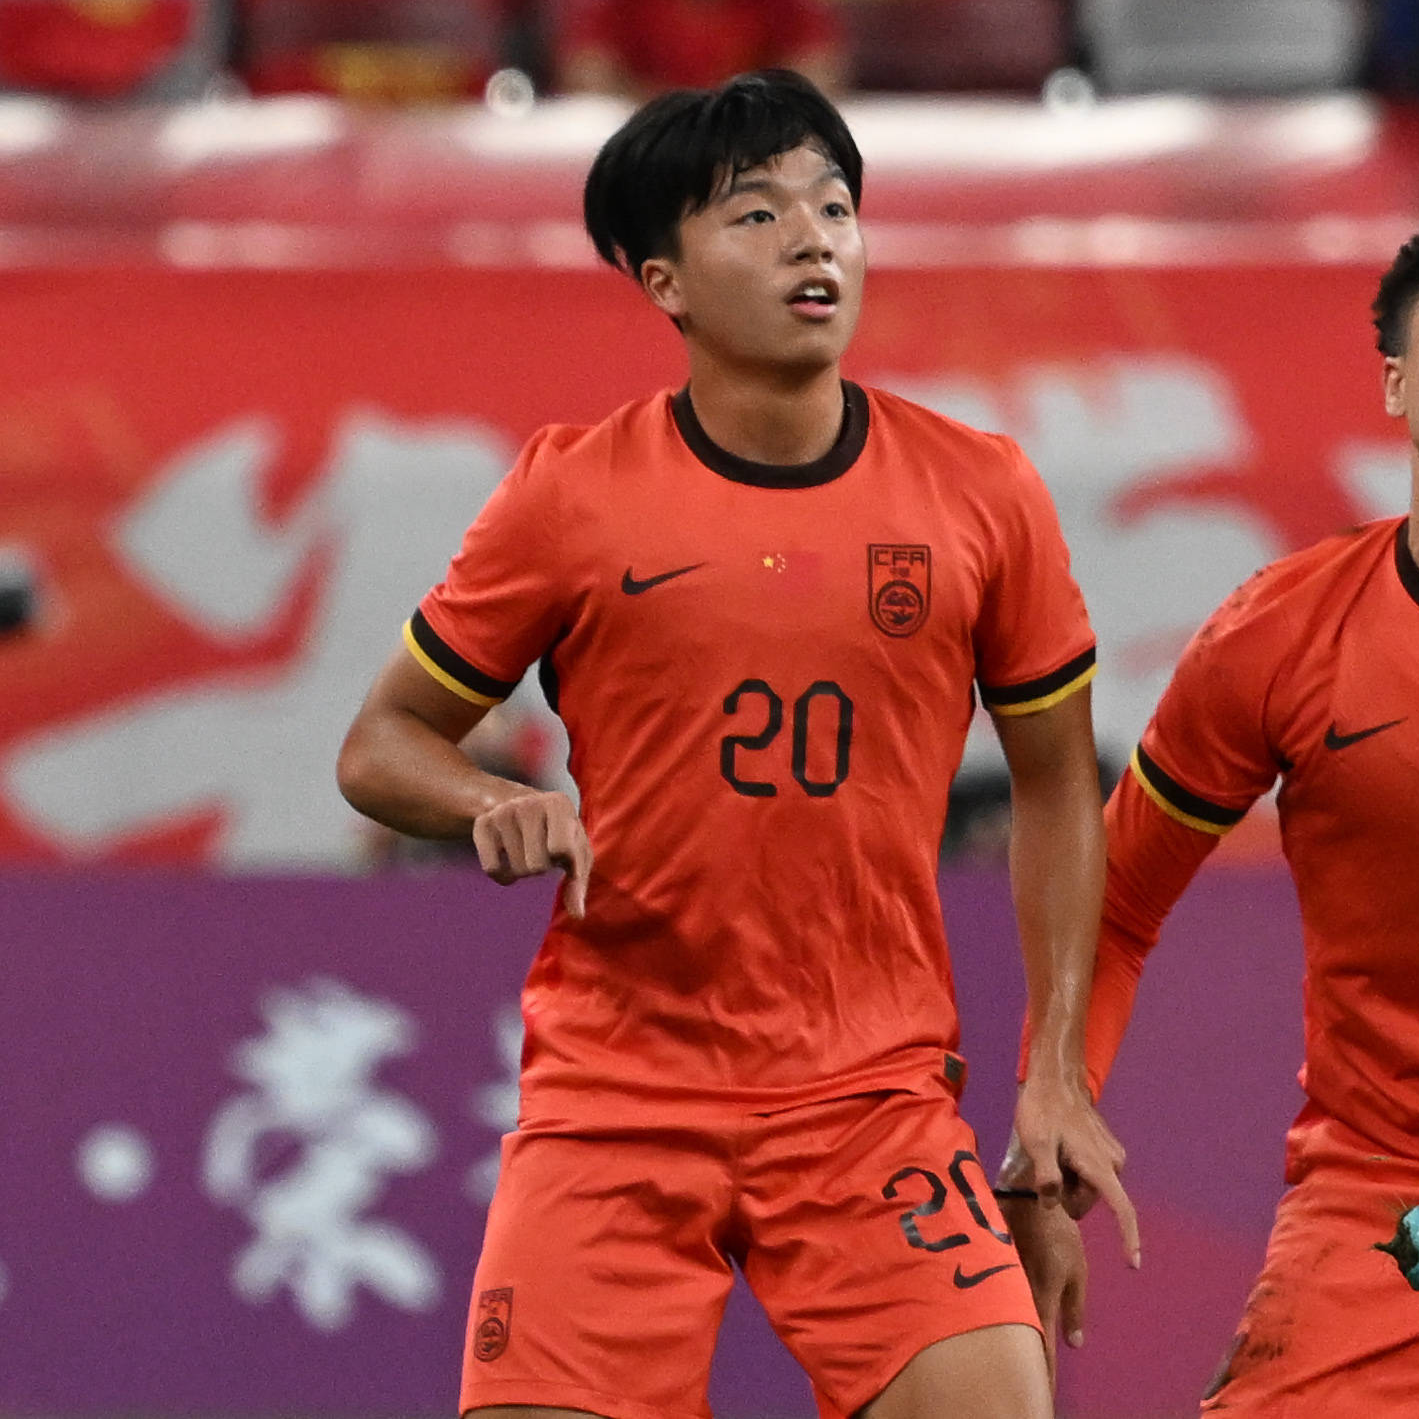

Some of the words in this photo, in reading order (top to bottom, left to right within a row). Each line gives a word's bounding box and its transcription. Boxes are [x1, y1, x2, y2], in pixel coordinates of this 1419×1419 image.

[874, 549, 927, 567] CFA
[719, 678, 854, 798] 20
[881, 1150, 1013, 1253] 20
